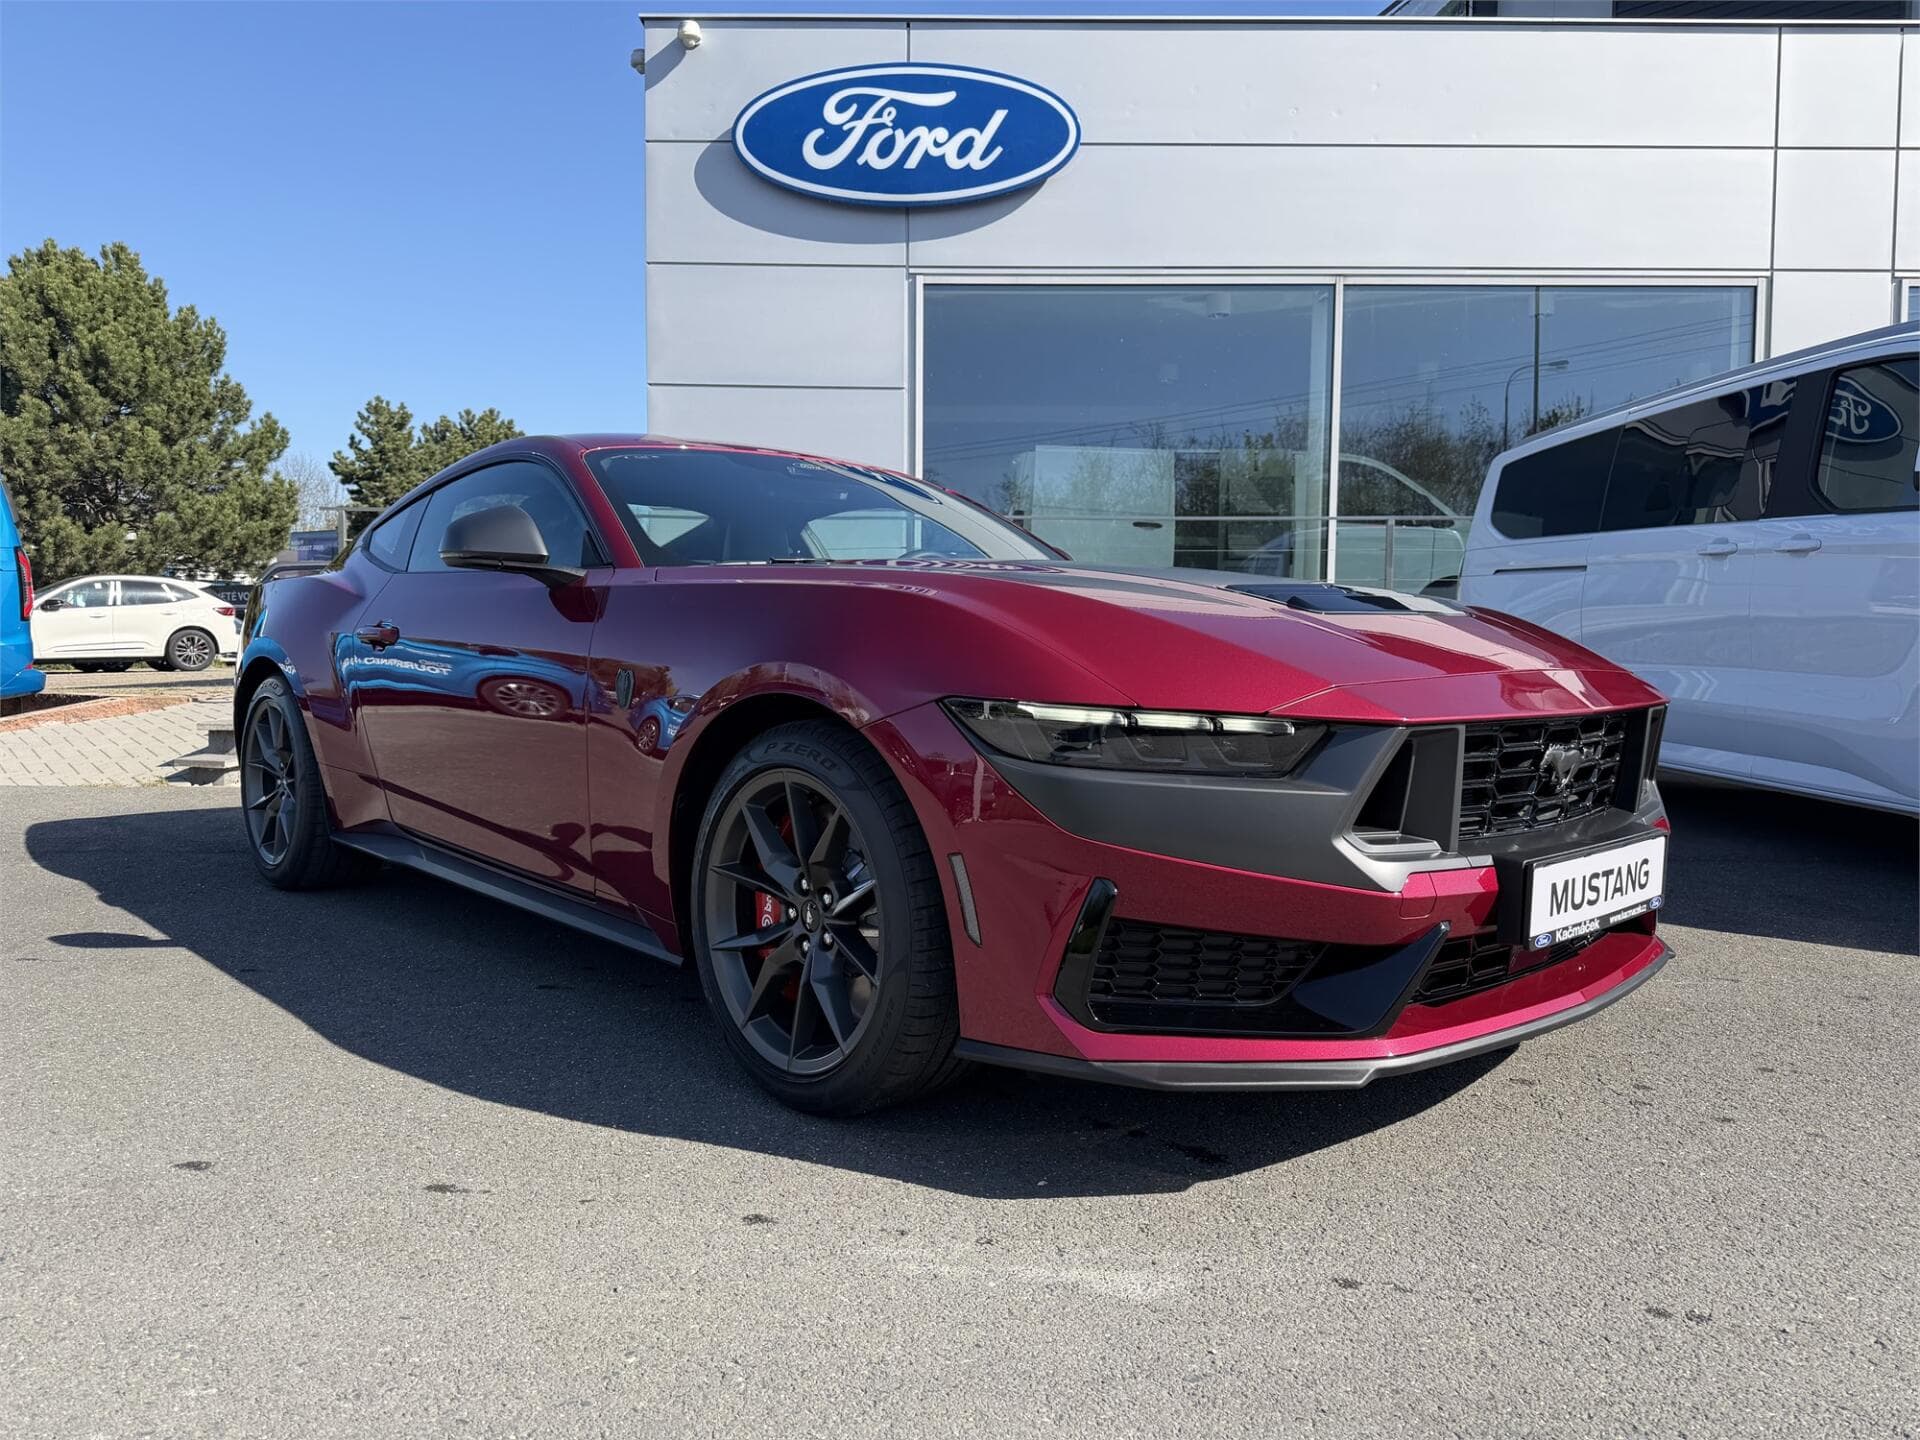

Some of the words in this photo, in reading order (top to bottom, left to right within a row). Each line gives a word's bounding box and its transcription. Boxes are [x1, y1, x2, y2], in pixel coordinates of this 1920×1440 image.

[802, 87, 1008, 170] Ford
[780, 742, 837, 771] ZERO
[1550, 858, 1649, 917] MUSTANG
[1555, 918, 1600, 942] Kačmáček
